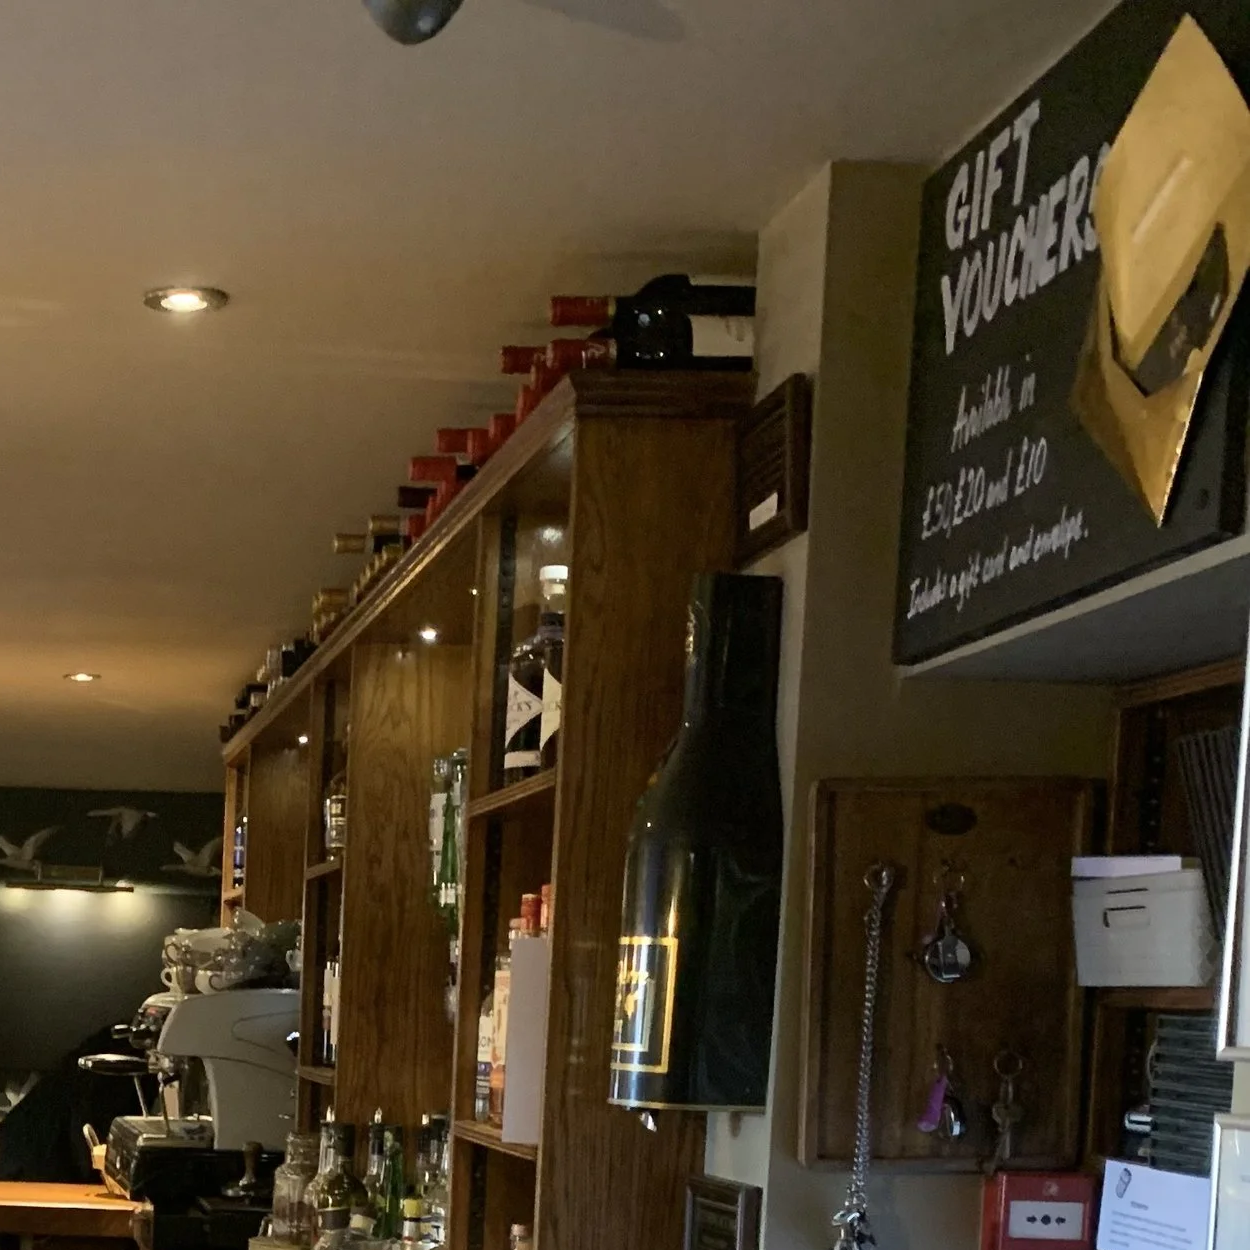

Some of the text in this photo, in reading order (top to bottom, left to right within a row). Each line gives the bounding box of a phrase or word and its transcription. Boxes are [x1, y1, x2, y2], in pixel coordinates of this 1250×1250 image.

[946, 99, 1040, 250] GIFT
[951, 353, 1036, 453] Available in
[986, 449, 1013, 510] and
[1014, 436, 1048, 497] £10
[956, 552, 981, 613] gift
